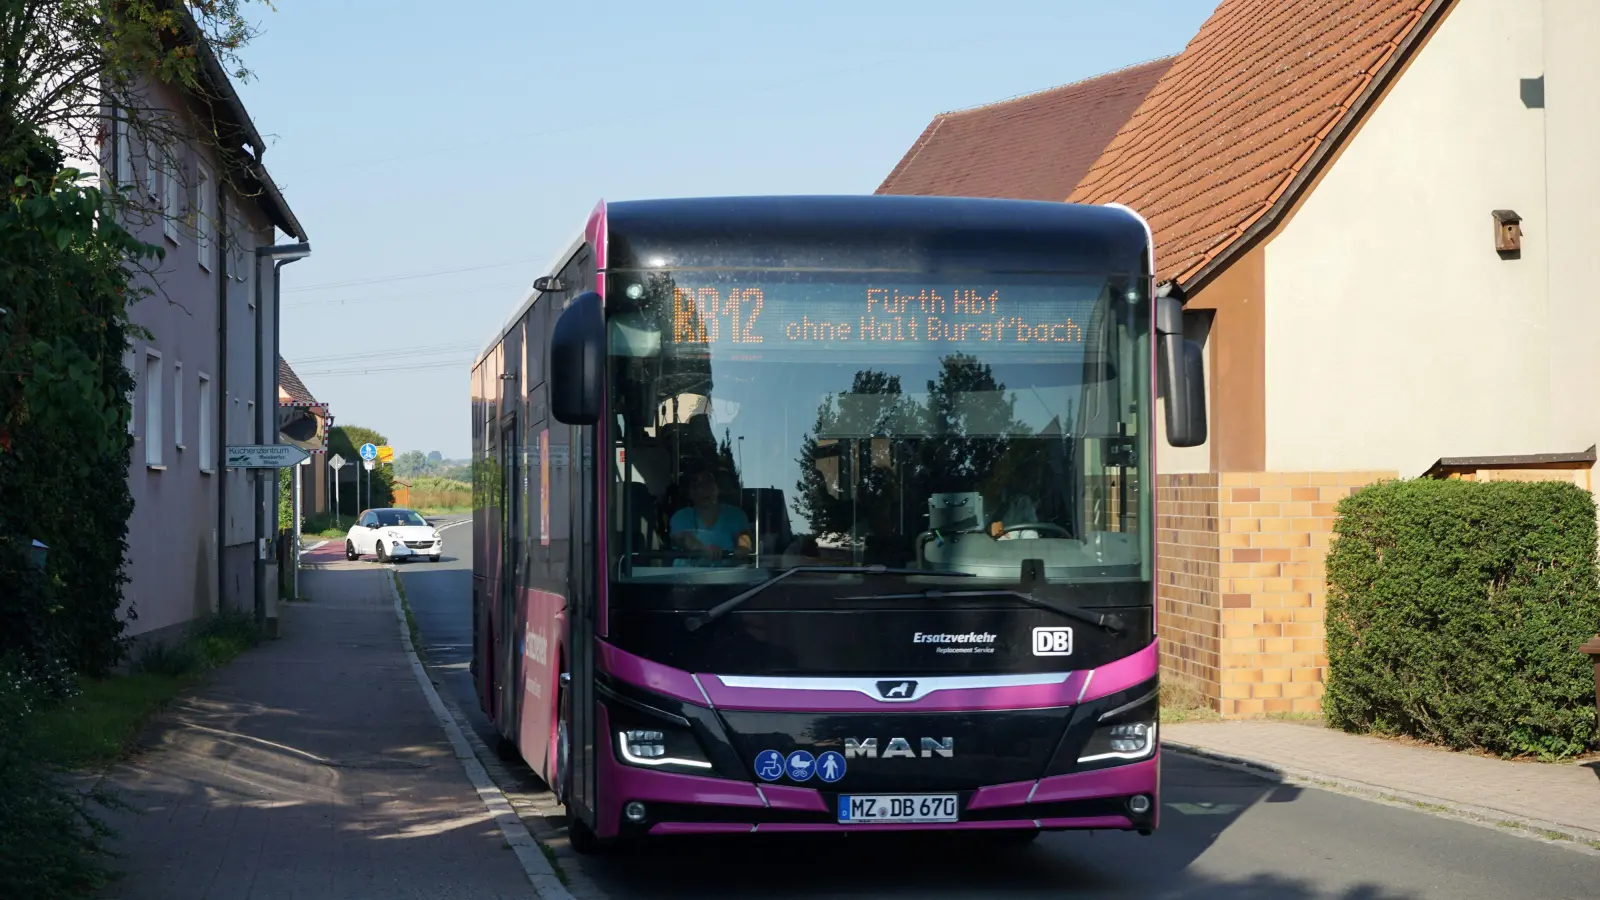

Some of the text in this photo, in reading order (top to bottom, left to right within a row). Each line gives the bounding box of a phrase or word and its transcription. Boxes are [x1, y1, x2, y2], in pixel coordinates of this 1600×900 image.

[866, 288, 999, 314] Fürth Hbf
[674, 287, 764, 344] RB12
[785, 315, 851, 341] ohne
[860, 316, 919, 341] Halt
[913, 631, 997, 644] Ersatzverkehr
[1036, 630, 1070, 653] DB
[936, 646, 995, 654] Replacement Service
[844, 737, 954, 759] MAN
[851, 798, 877, 818] MZ
[890, 798, 915, 818] DB
[920, 797, 956, 817] 670
